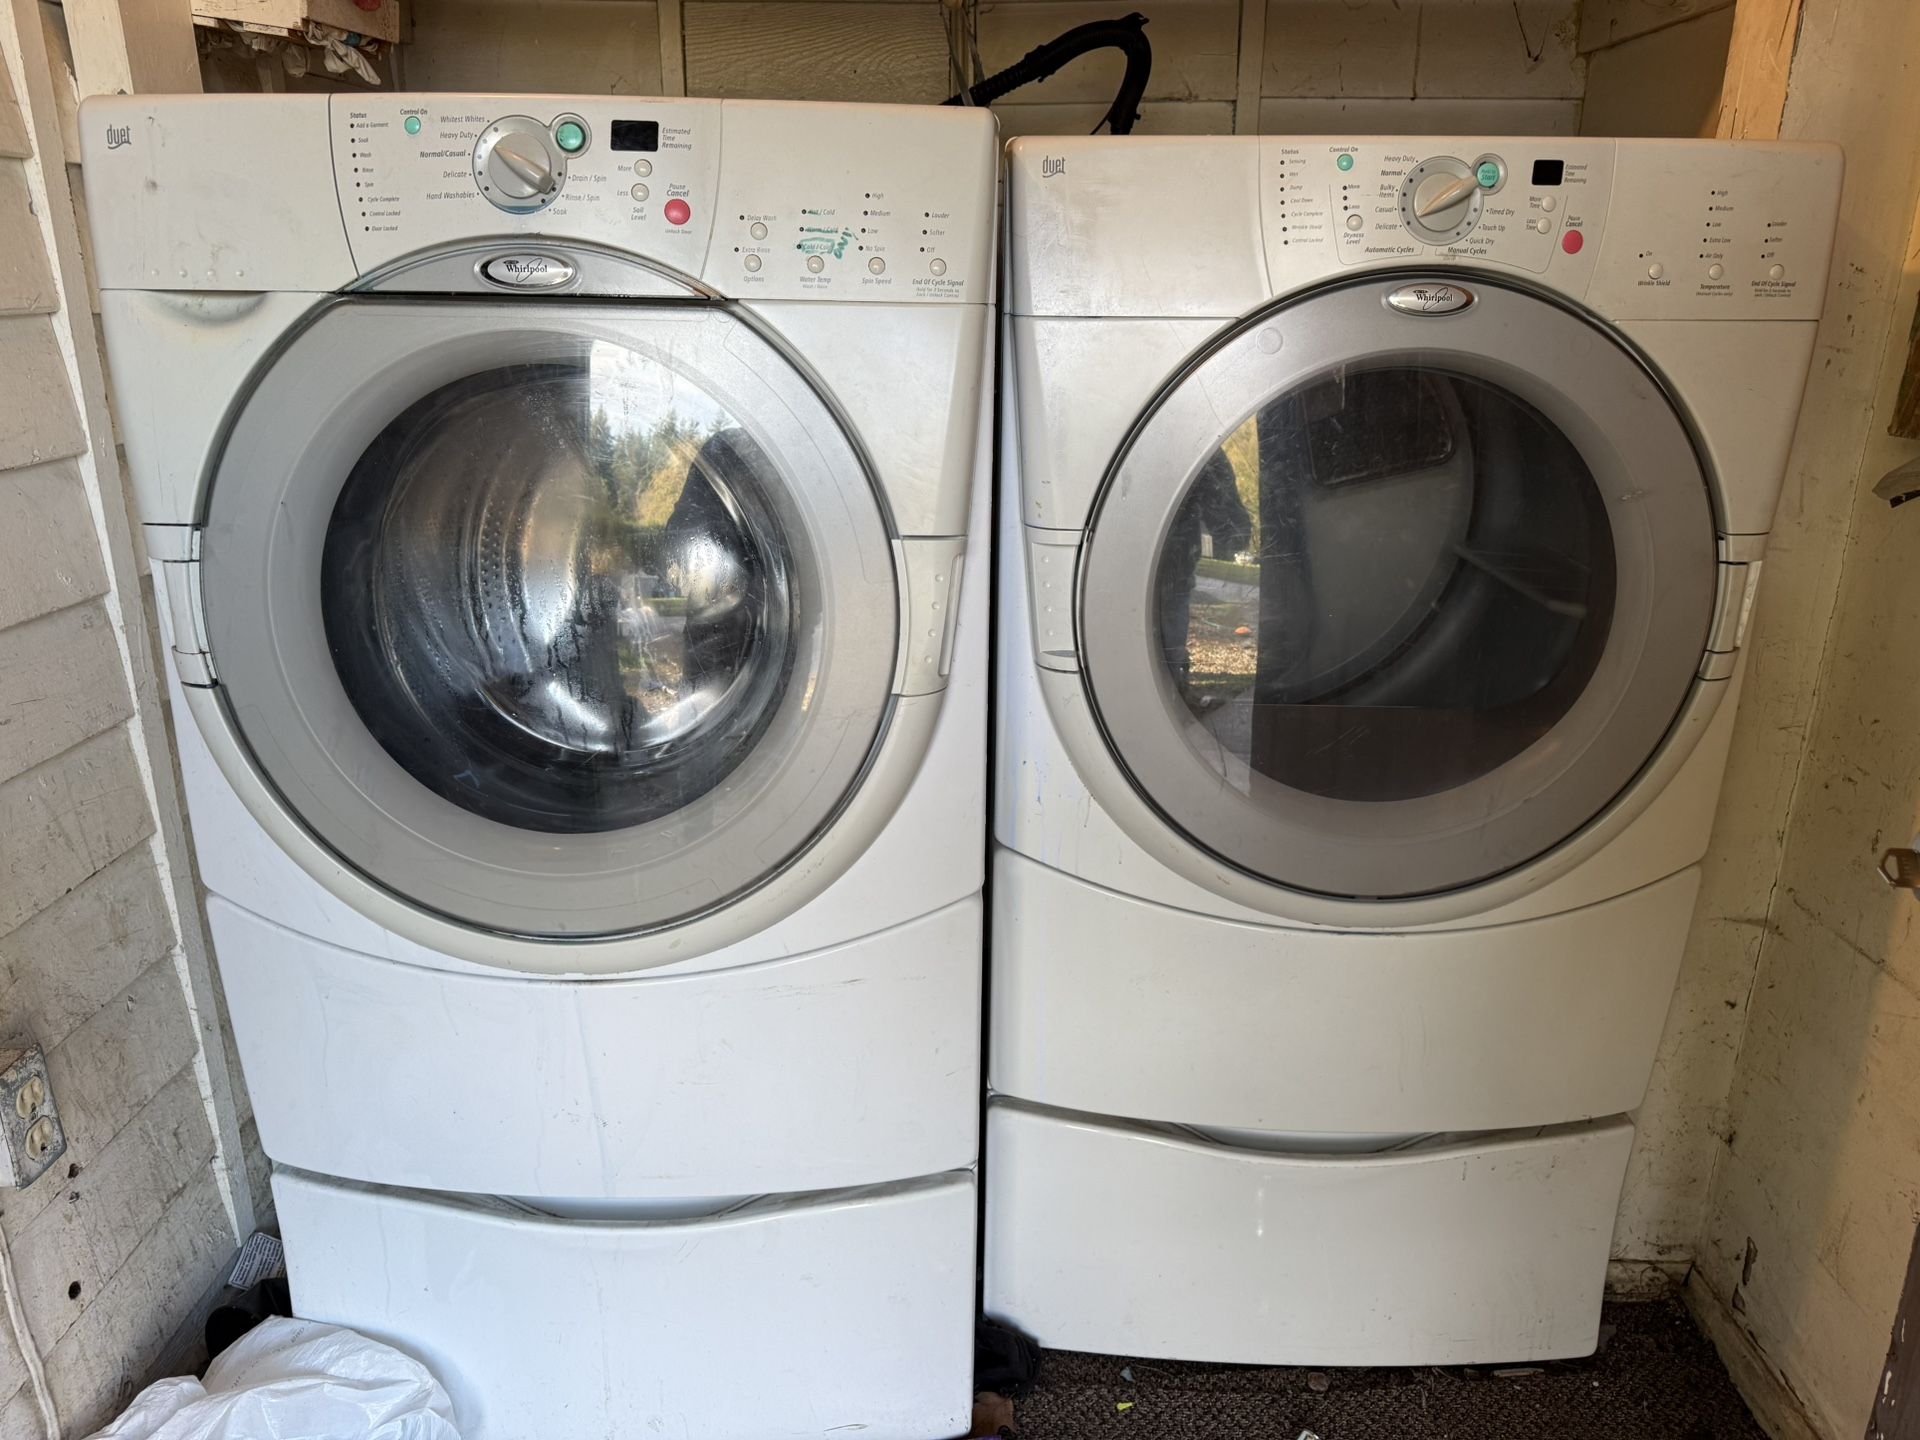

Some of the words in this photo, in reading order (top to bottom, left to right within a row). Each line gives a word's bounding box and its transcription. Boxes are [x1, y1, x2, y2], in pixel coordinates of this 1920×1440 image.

[106, 123, 132, 149] duet
[440, 132, 458, 140] Heavy
[460, 131, 473, 139] Duty
[662, 142, 692, 151] Remaining
[420, 150, 466, 158] Normal/Casual
[1042, 155, 1066, 178] duet
[506, 264, 547, 274] Whirlpool
[1416, 294, 1452, 303] Whirlpool
